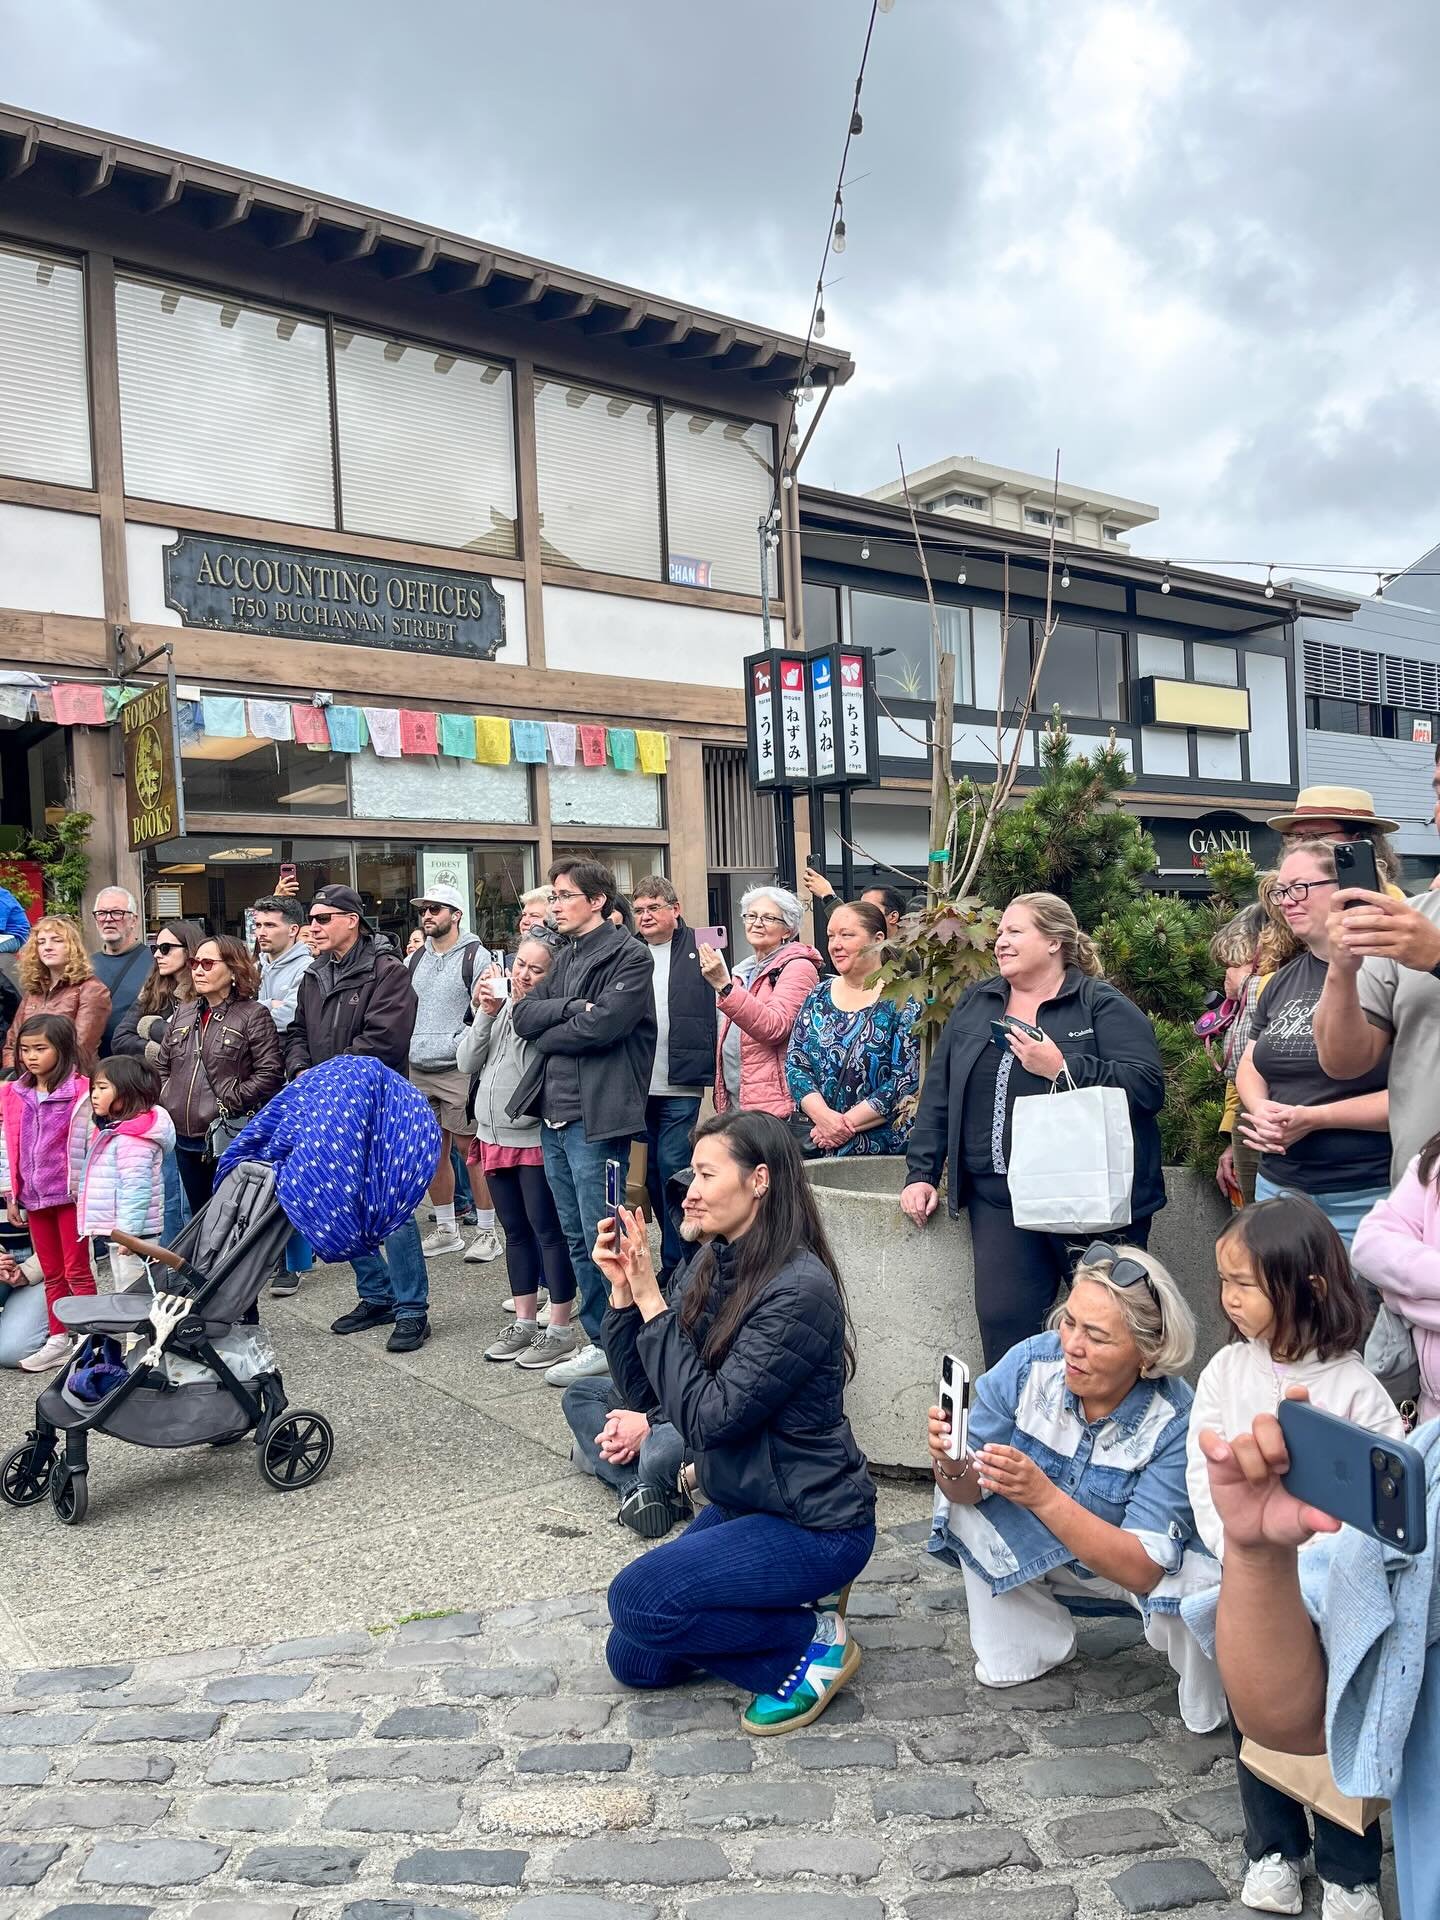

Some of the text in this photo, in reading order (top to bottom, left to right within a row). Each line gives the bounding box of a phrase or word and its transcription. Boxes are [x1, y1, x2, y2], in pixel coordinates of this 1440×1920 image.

[197, 551, 482, 619] ACCOUNTING OFFICES
[669, 563, 696, 583] CHAN
[230, 596, 457, 641] 1750 BUCHANAN STREET
[124, 684, 168, 734] FOREST
[819, 710, 833, 752] ふね
[847, 703, 860, 756] ちょう
[760, 716, 773, 759] うま
[786, 706, 801, 760] ねずみ
[132, 804, 172, 845] BOOKS
[431, 860, 461, 868] FOREST
